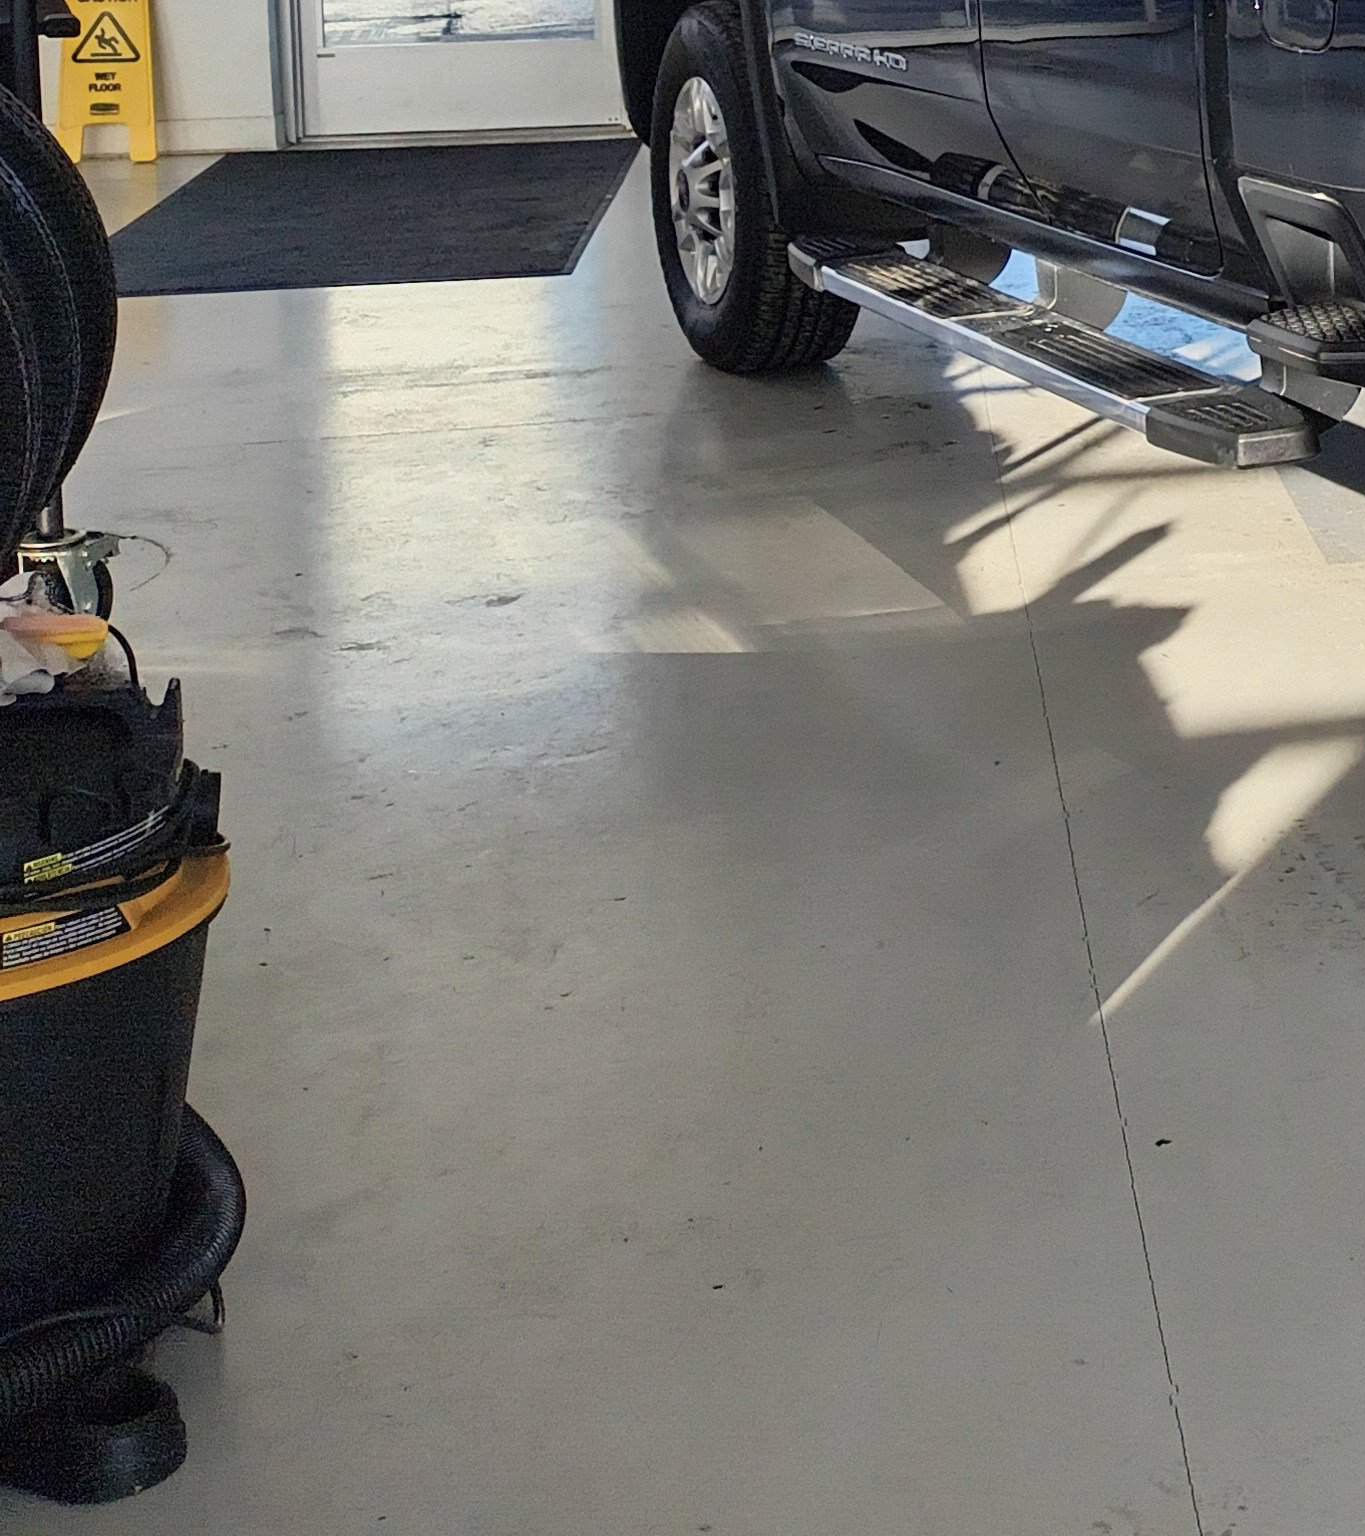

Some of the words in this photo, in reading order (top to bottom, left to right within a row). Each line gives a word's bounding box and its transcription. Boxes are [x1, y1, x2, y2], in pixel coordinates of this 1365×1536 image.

[794, 32, 871, 63] SIERRA
[873, 49, 907, 71] HD
[94, 71, 117, 82] WET
[88, 83, 122, 92] FLOOR
